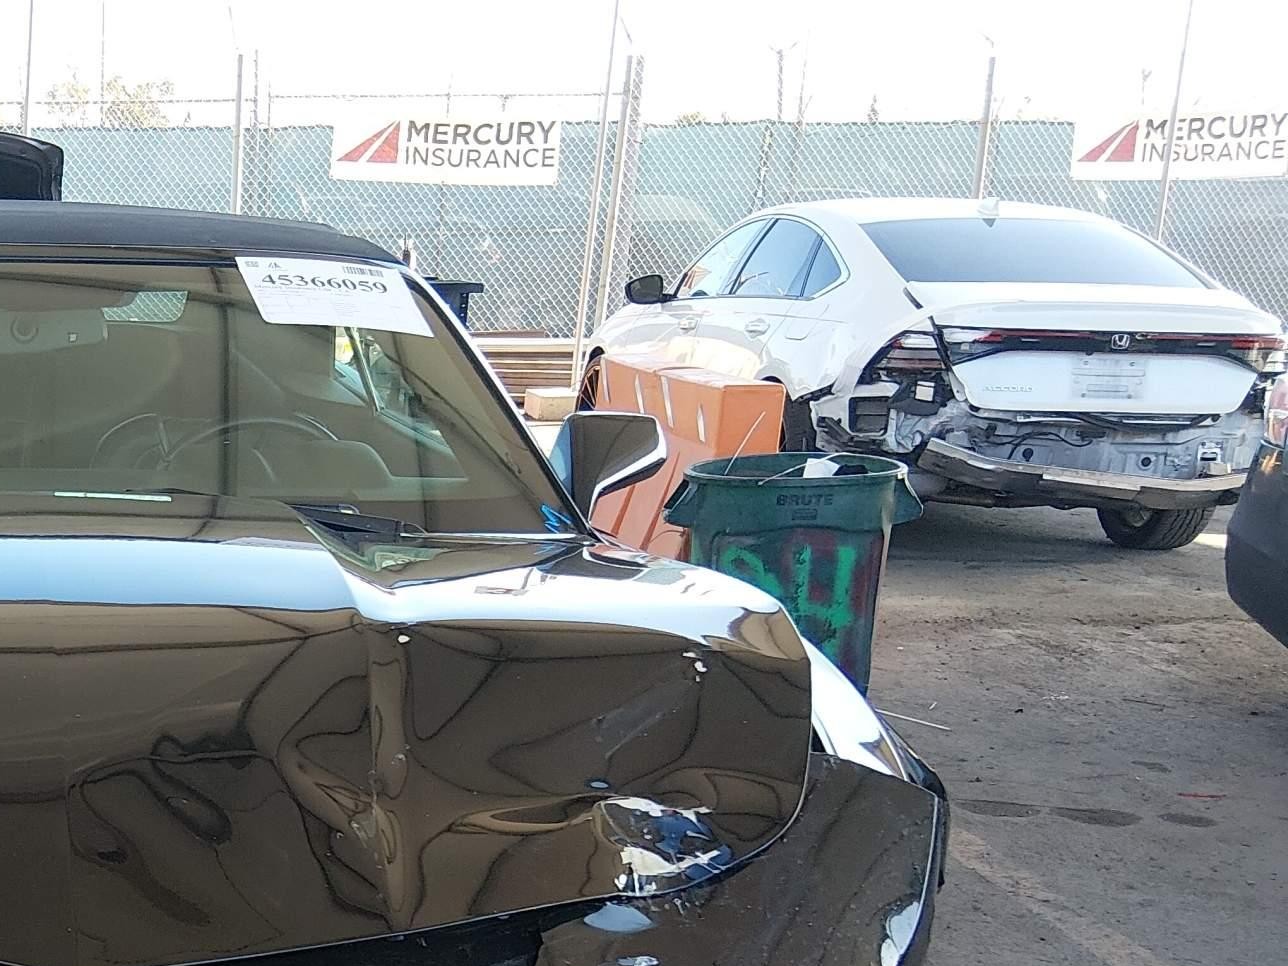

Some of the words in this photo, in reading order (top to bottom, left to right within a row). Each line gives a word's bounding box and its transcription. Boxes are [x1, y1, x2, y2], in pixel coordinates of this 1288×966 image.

[406, 120, 556, 145] MERCURY
[1144, 113, 1288, 140] MERCURY
[405, 146, 556, 168] INSURANCE
[1141, 140, 1287, 162] INSURANCE
[261, 273, 388, 294] 45366059
[776, 494, 833, 505] BRUTE
